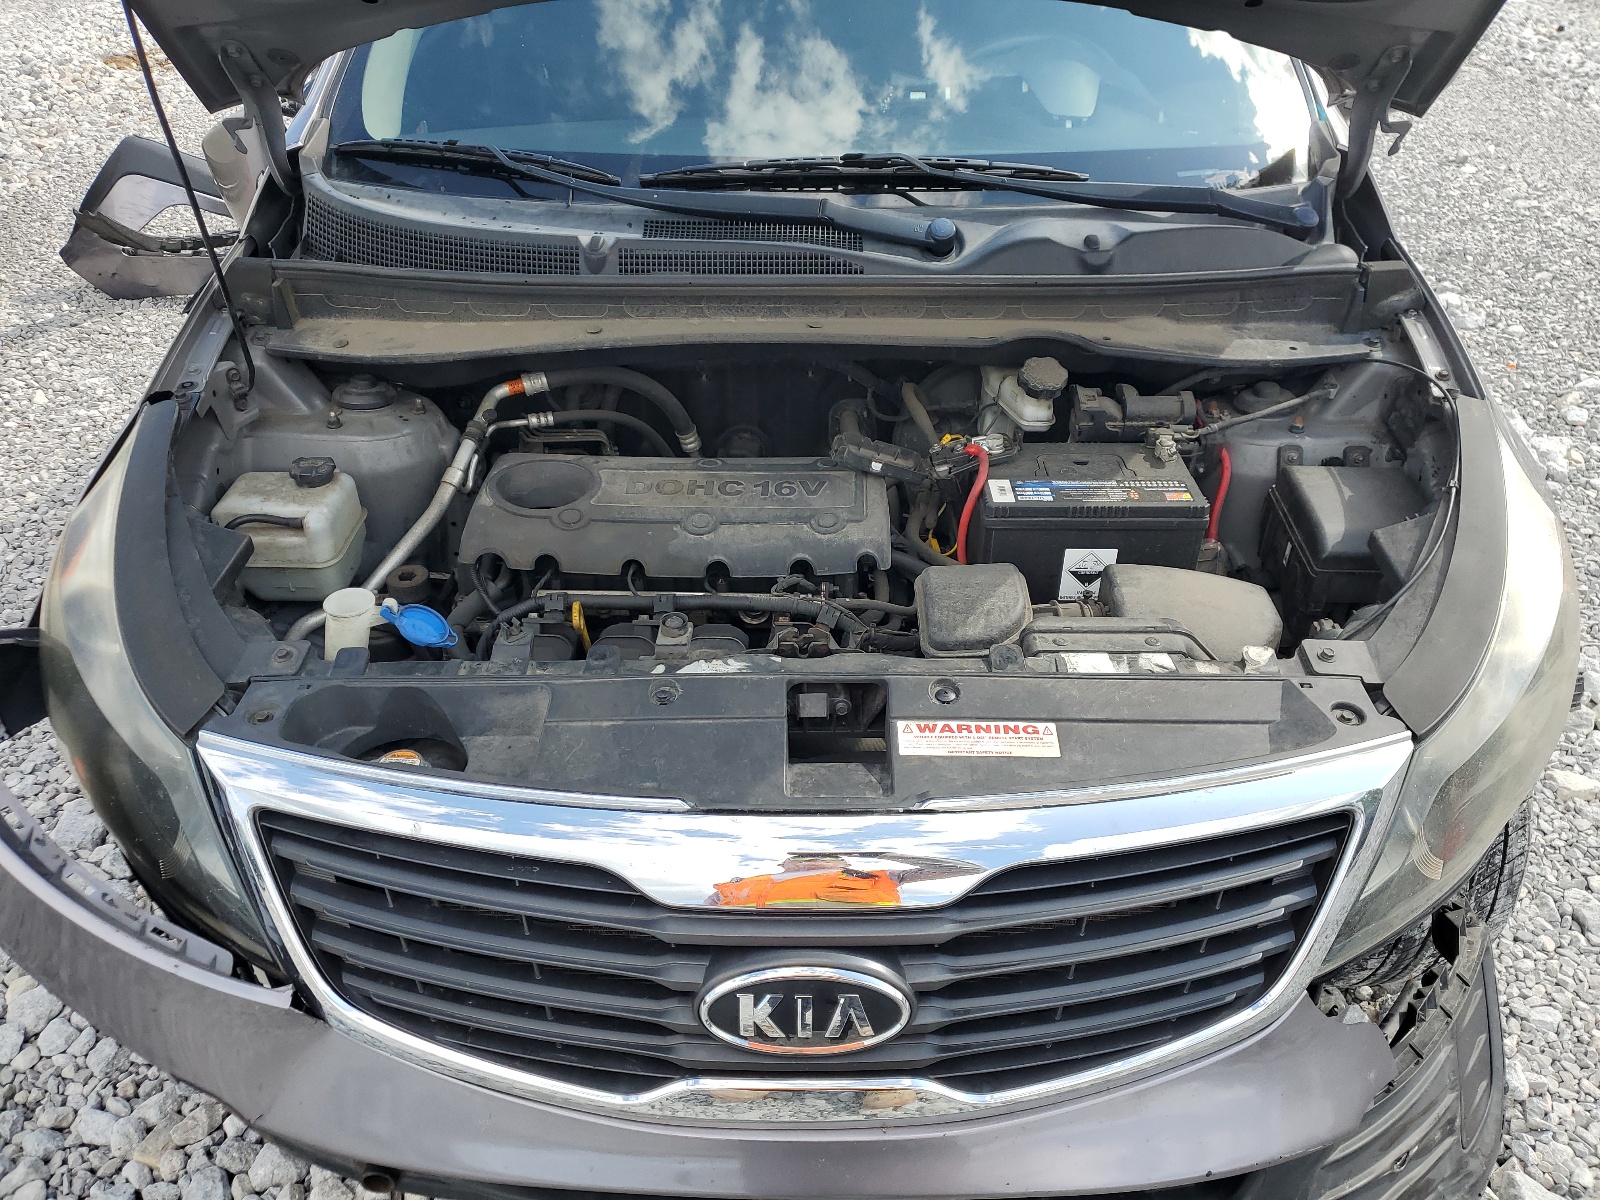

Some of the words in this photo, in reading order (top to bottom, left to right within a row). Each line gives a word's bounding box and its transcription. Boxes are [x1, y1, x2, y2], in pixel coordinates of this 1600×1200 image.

[624, 479, 745, 497] DOHC
[753, 480, 828, 497] 16V
[916, 724, 1040, 735] WARNING
[736, 993, 876, 1038] KIA
